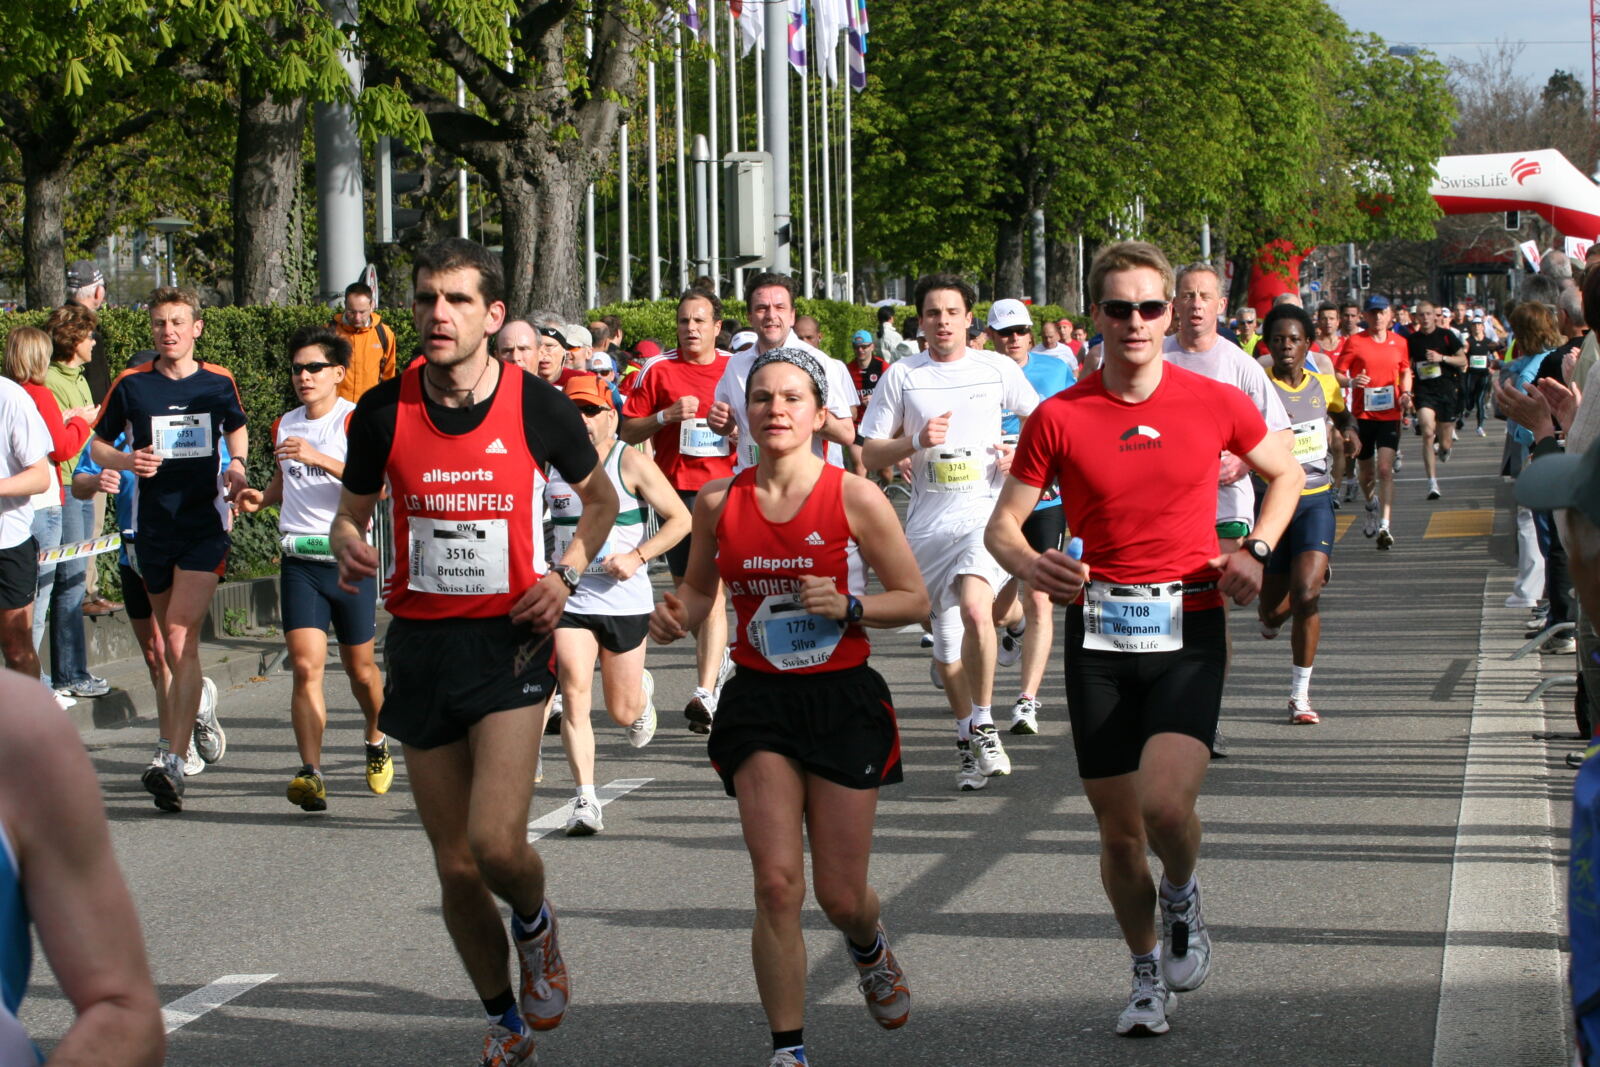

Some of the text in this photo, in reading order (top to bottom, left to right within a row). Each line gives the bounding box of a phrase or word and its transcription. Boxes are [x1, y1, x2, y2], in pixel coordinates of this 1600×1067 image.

[177, 430, 193, 438] 6751
[1119, 440, 1162, 452] skinfit
[422, 468, 494, 484] allsports
[404, 494, 514, 512] LG HOHENFELS
[456, 523, 477, 531] ewz
[446, 548, 475, 560] 3516
[742, 556, 814, 571] allsports
[437, 565, 485, 577] Brutschin
[436, 583, 485, 593] Swiss Life
[1122, 605, 1150, 617] 7108
[786, 619, 816, 634] 1776
[1113, 622, 1160, 636] Wegmann
[791, 638, 817, 651] Silva
[1113, 640, 1159, 649] Swiss Life
[781, 651, 831, 668] Swiss Life
